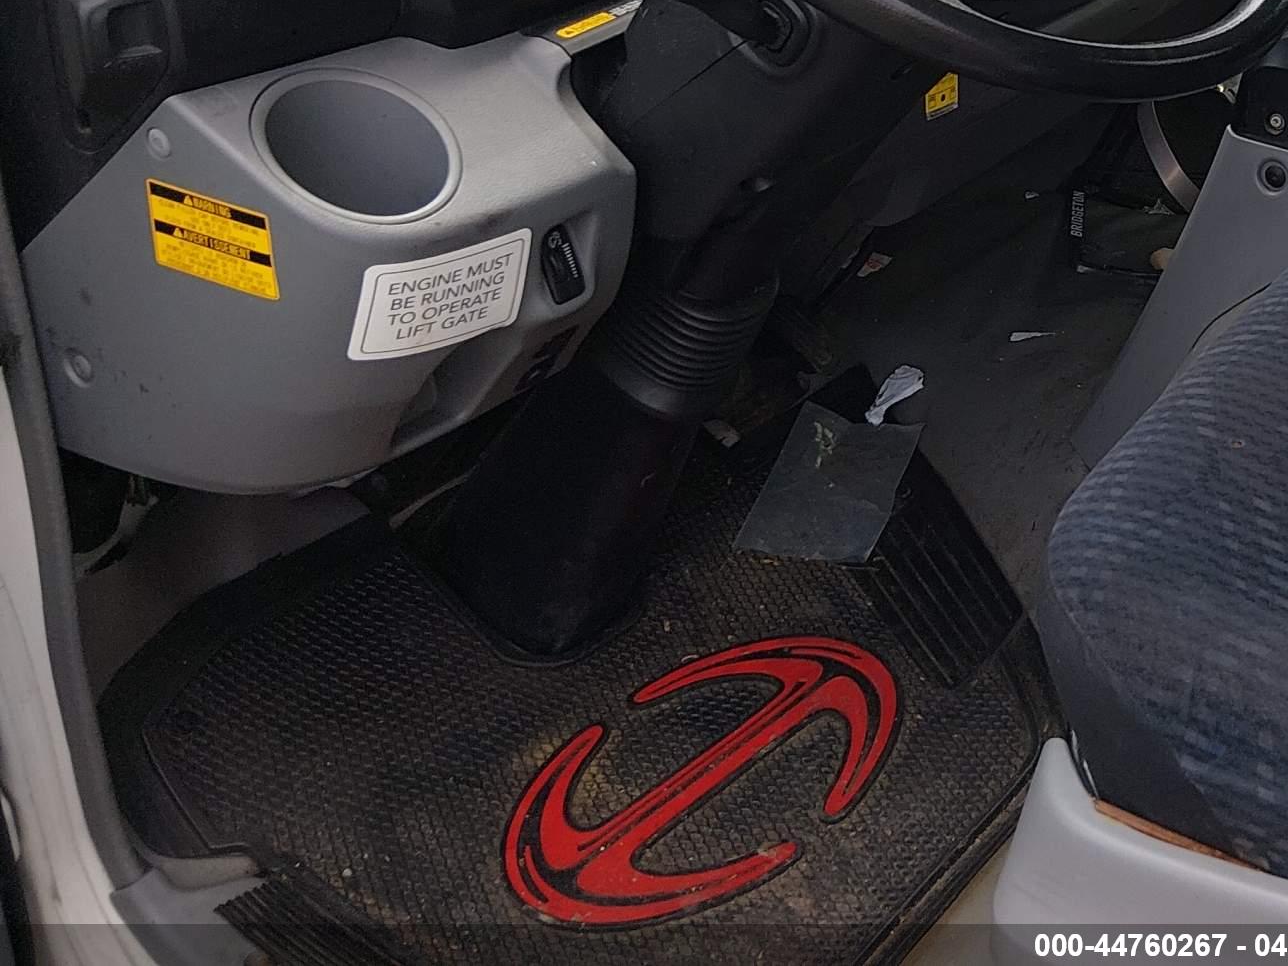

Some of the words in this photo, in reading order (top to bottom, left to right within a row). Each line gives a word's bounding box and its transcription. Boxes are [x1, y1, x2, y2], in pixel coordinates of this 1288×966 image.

[1070, 190, 1085, 238] BRIDGETON
[388, 268, 462, 296] ENGINE
[467, 252, 514, 280] MUST
[391, 295, 417, 311] BE
[420, 271, 505, 306] RUNNING
[388, 311, 416, 326] TO
[422, 287, 503, 319] OPERATE
[396, 322, 435, 340] LIFT
[441, 306, 489, 330] GATE
